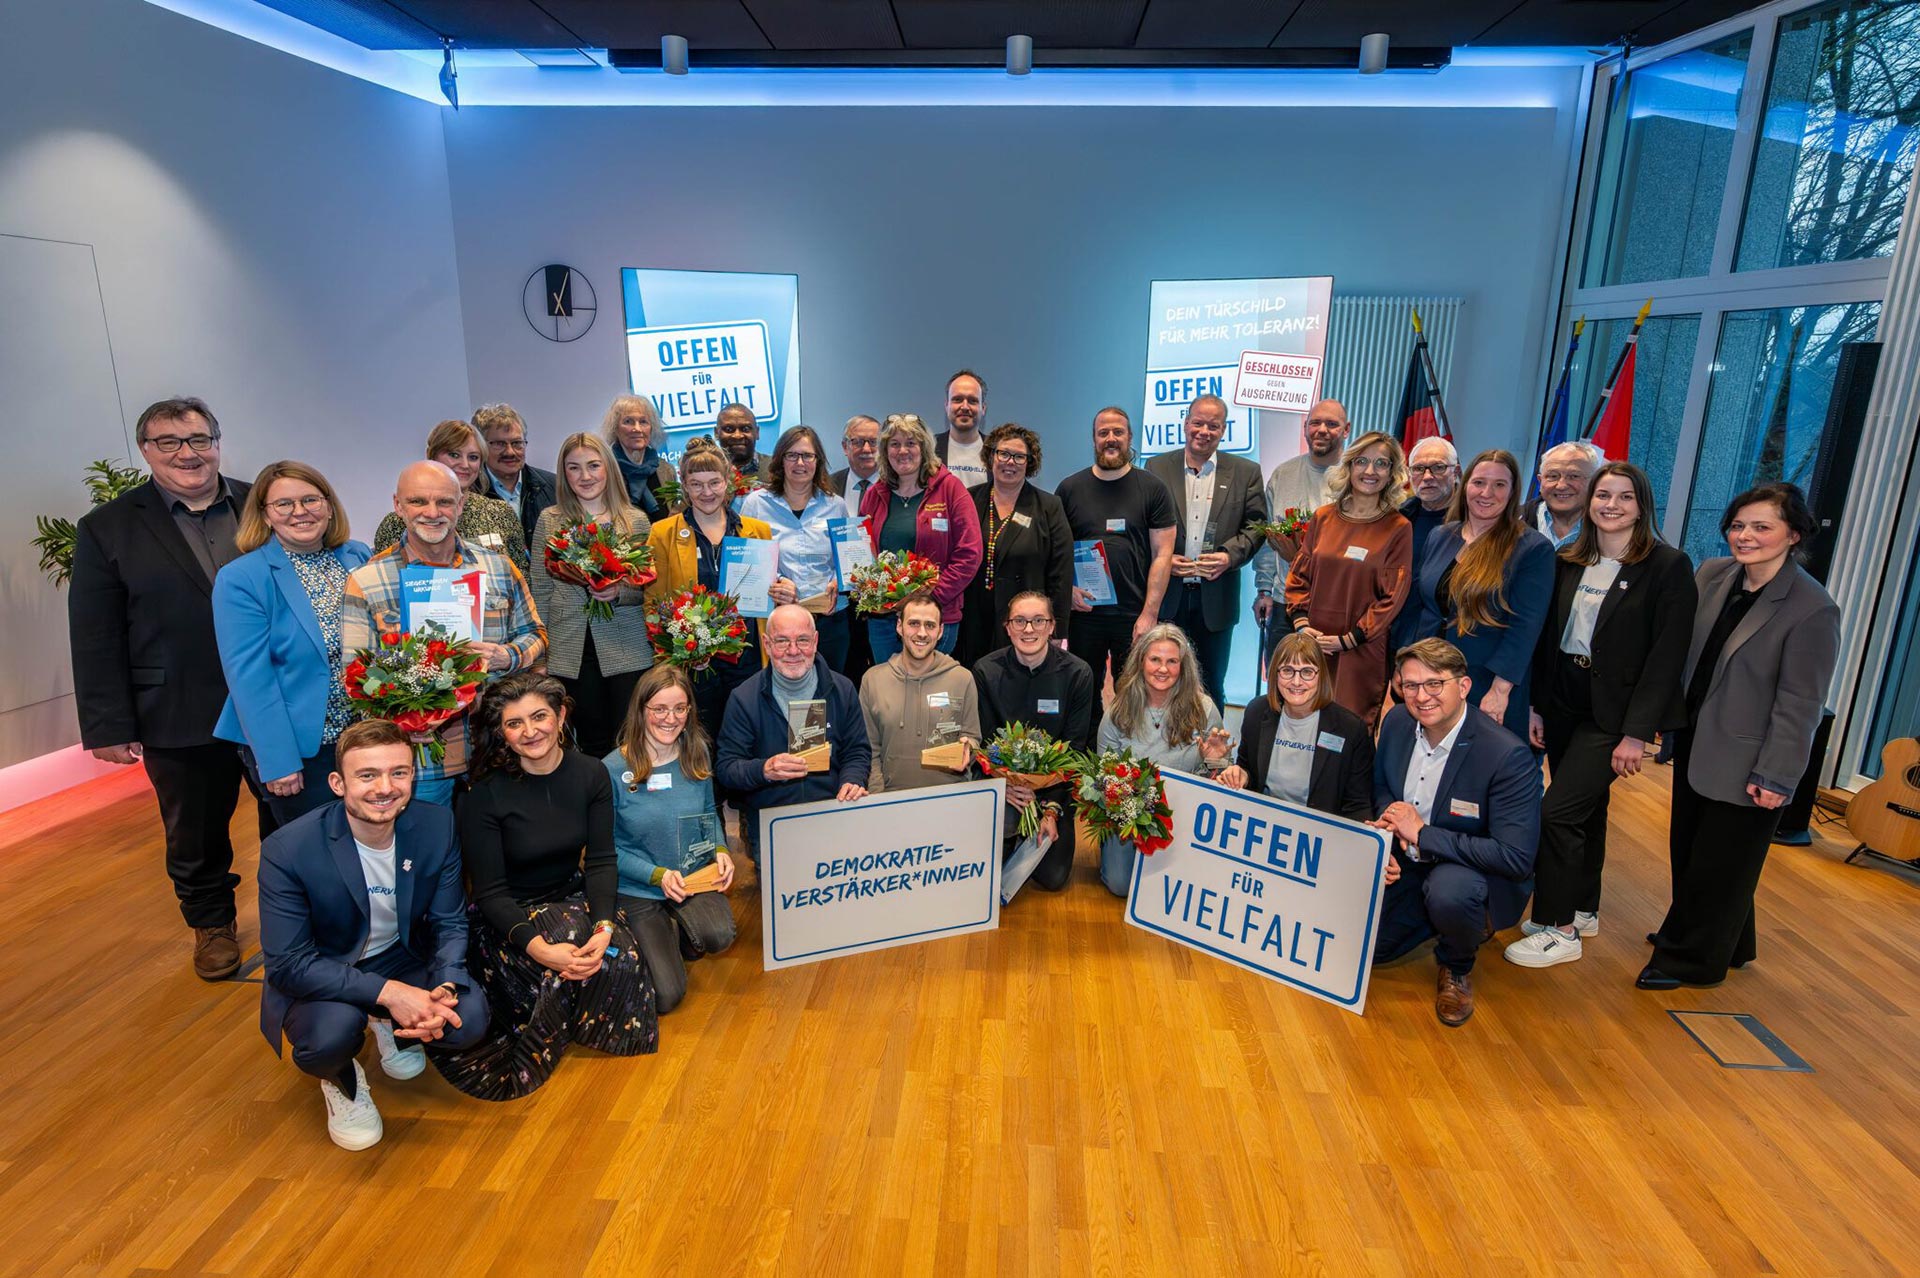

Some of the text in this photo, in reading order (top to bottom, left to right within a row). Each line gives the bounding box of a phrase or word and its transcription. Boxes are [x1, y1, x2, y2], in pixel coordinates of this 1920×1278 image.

[1166, 297, 1286, 322] DEIN TÜRSCHILD
[1159, 314, 1321, 345] FÜR MEHR TOLERANZ!
[658, 336, 738, 366] OFFEN
[692, 372, 713, 386] FÜR
[1245, 361, 1314, 377] GESCHLOSSEN
[1155, 376, 1222, 401] OFFEN
[1241, 388, 1308, 404] AUSGRENZUNG
[1267, 379, 1286, 388] GEGEN
[1193, 802, 1323, 879] OFFEN
[815, 844, 955, 880] DEMOKRATIE-
[1231, 871, 1264, 898] FÜR
[1164, 874, 1335, 972] VIELFALT
